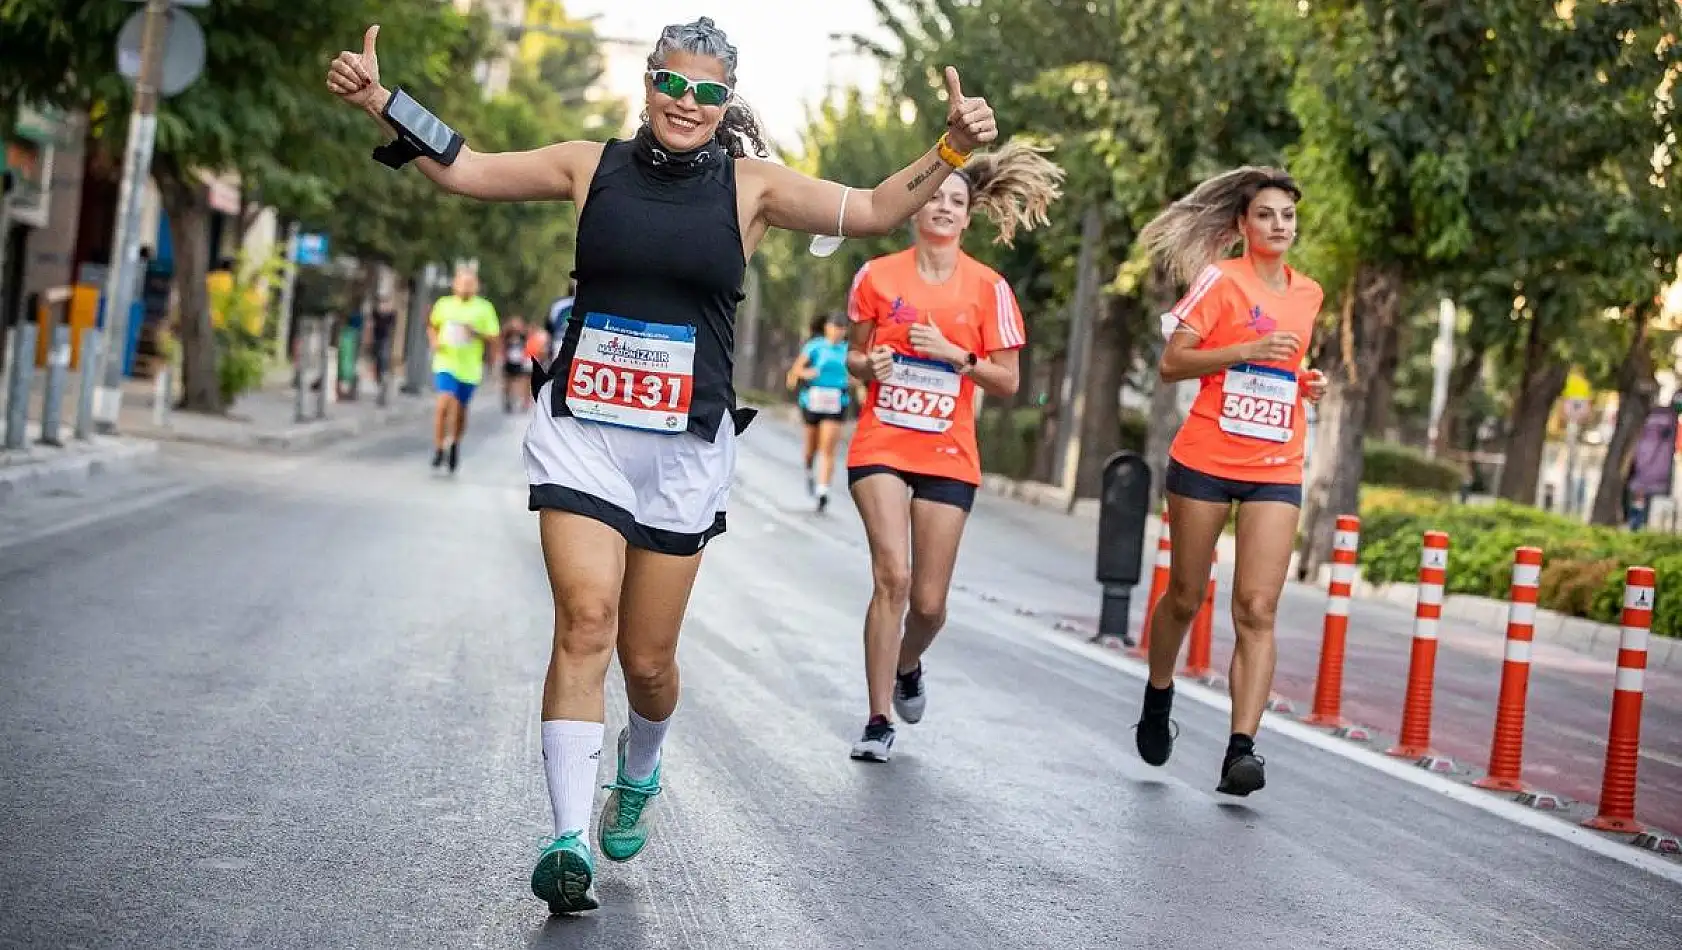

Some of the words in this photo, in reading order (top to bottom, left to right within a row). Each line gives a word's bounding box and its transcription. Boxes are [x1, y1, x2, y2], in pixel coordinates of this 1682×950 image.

[573, 363, 681, 408] 50131
[877, 385, 956, 418] 50679
[1223, 396, 1292, 428] 50251
